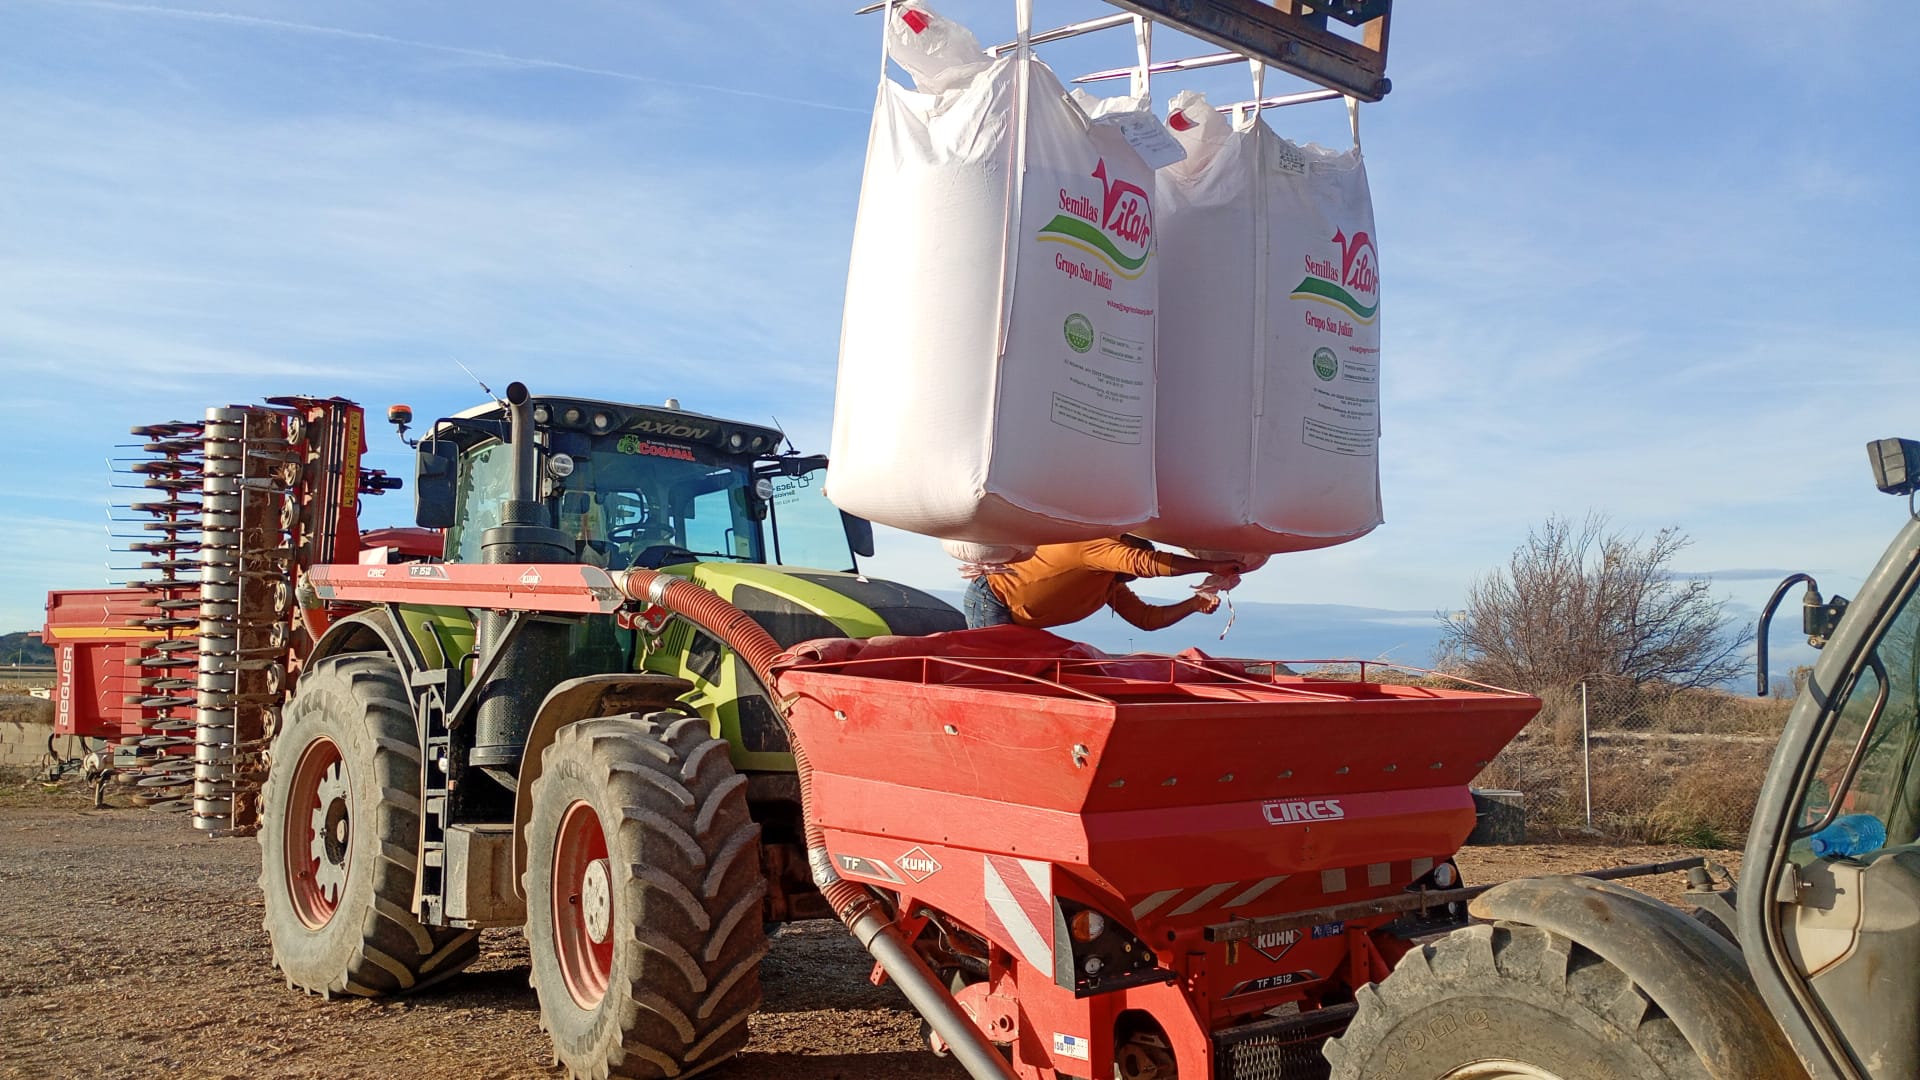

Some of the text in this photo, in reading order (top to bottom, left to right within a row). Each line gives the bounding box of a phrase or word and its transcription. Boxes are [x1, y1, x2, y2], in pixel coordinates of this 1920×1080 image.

[1059, 188, 1098, 223] Semillas
[1055, 252, 1079, 279] Grupo
[1079, 262, 1093, 285] San
[1305, 254, 1338, 281] Semillas
[1305, 310, 1326, 332] Grupo
[1326, 317, 1337, 334] San
[628, 420, 710, 439] AXION
[59, 646, 73, 726] BEGUER
[1262, 799, 1345, 822] CIRES
[842, 856, 861, 870] TF
[901, 857, 935, 873] KUHN
[1257, 929, 1295, 949] KUHN
[1256, 973, 1293, 989] TF 1512
